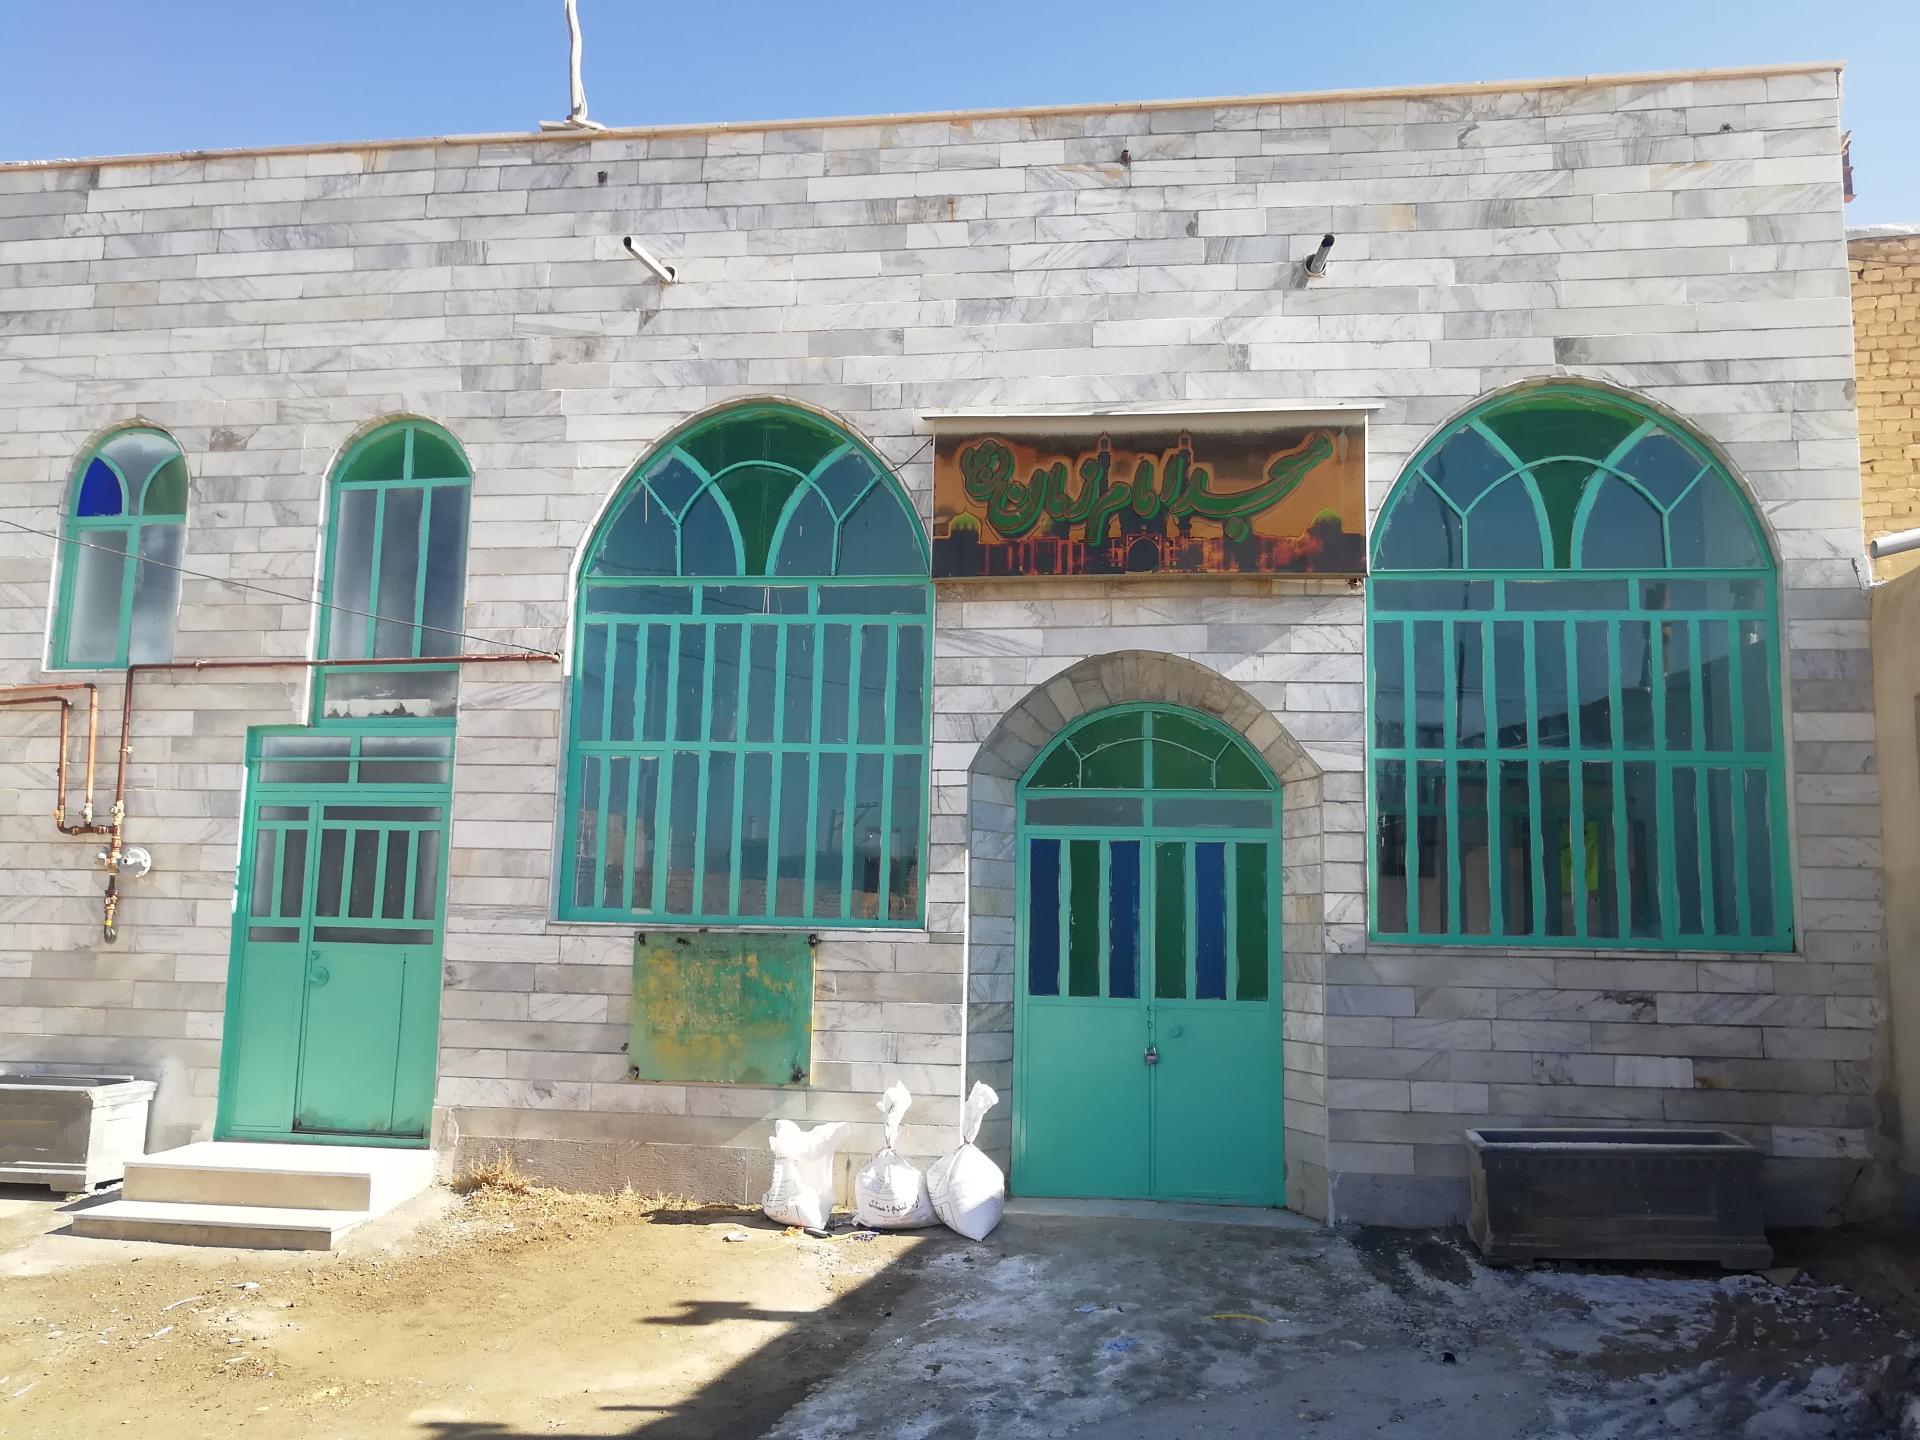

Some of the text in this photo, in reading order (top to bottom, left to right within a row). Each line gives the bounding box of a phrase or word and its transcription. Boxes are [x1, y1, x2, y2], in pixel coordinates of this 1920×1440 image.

[987, 456, 1103, 537] زمان
[1083, 452, 1185, 547] امام
[1168, 431, 1334, 544] مسجد
